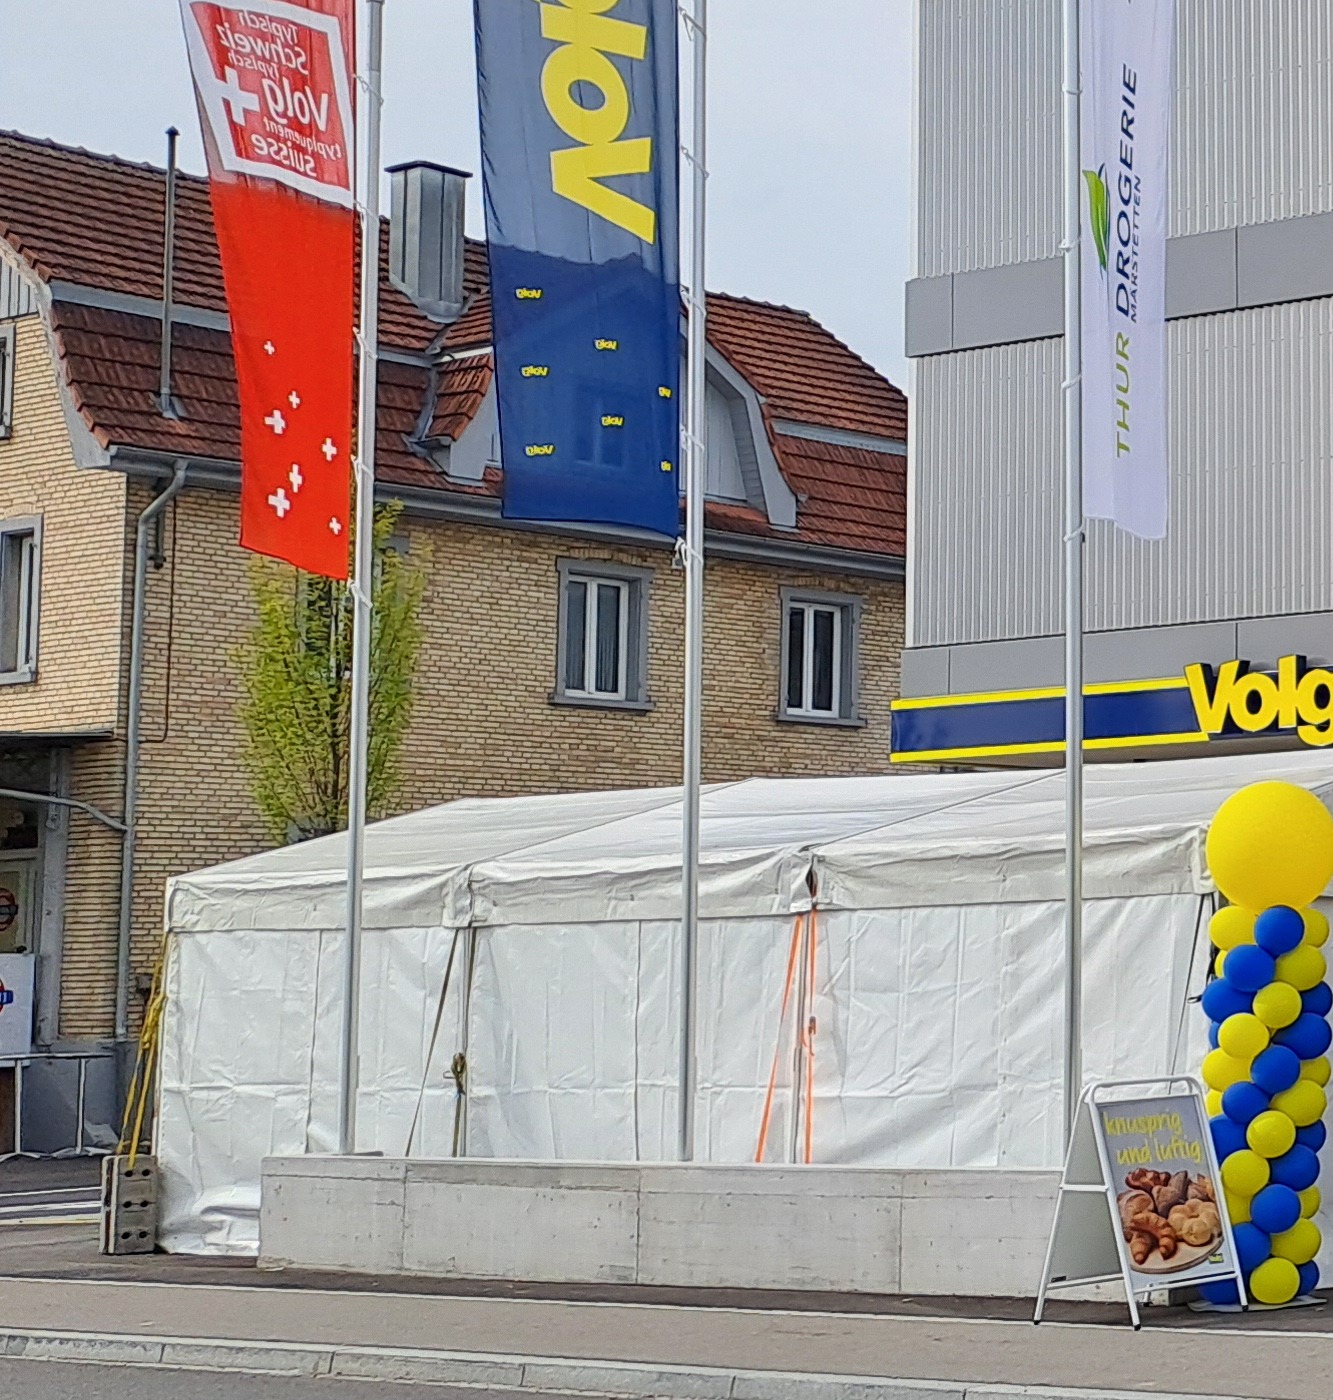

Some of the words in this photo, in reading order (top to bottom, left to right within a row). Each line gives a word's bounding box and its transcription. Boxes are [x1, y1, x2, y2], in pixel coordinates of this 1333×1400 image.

[1116, 63, 1137, 317] DROGERIE
[1130, 175, 1142, 323] MÄRSTETTEN
[1115, 331, 1130, 458] THUR
[1103, 1108, 1183, 1137] knusprig
[1117, 1140, 1153, 1165] und
[1154, 1135, 1202, 1164] luftig
